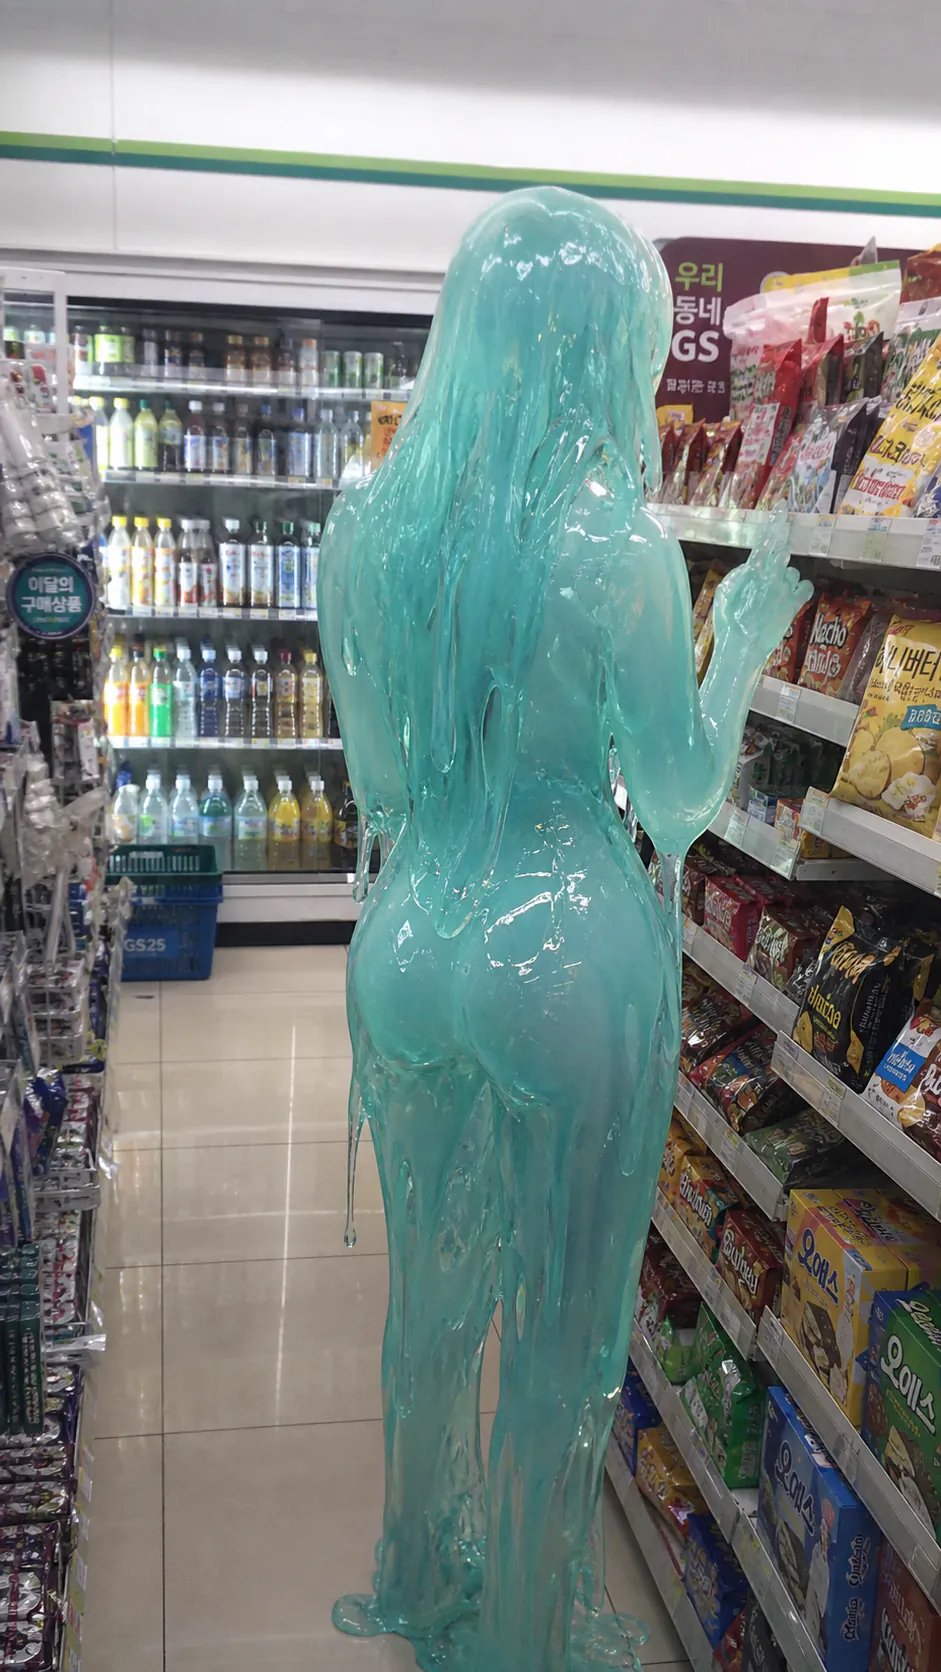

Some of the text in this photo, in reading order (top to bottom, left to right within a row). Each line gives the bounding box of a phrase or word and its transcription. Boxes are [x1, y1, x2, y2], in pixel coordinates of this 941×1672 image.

[675, 262, 724, 292] 우리
[674, 296, 722, 326] 동네
[671, 329, 720, 363] GS
[28, 576, 74, 593] 이달의
[21, 596, 82, 613] 구매상품
[124, 938, 167, 952] GS25
